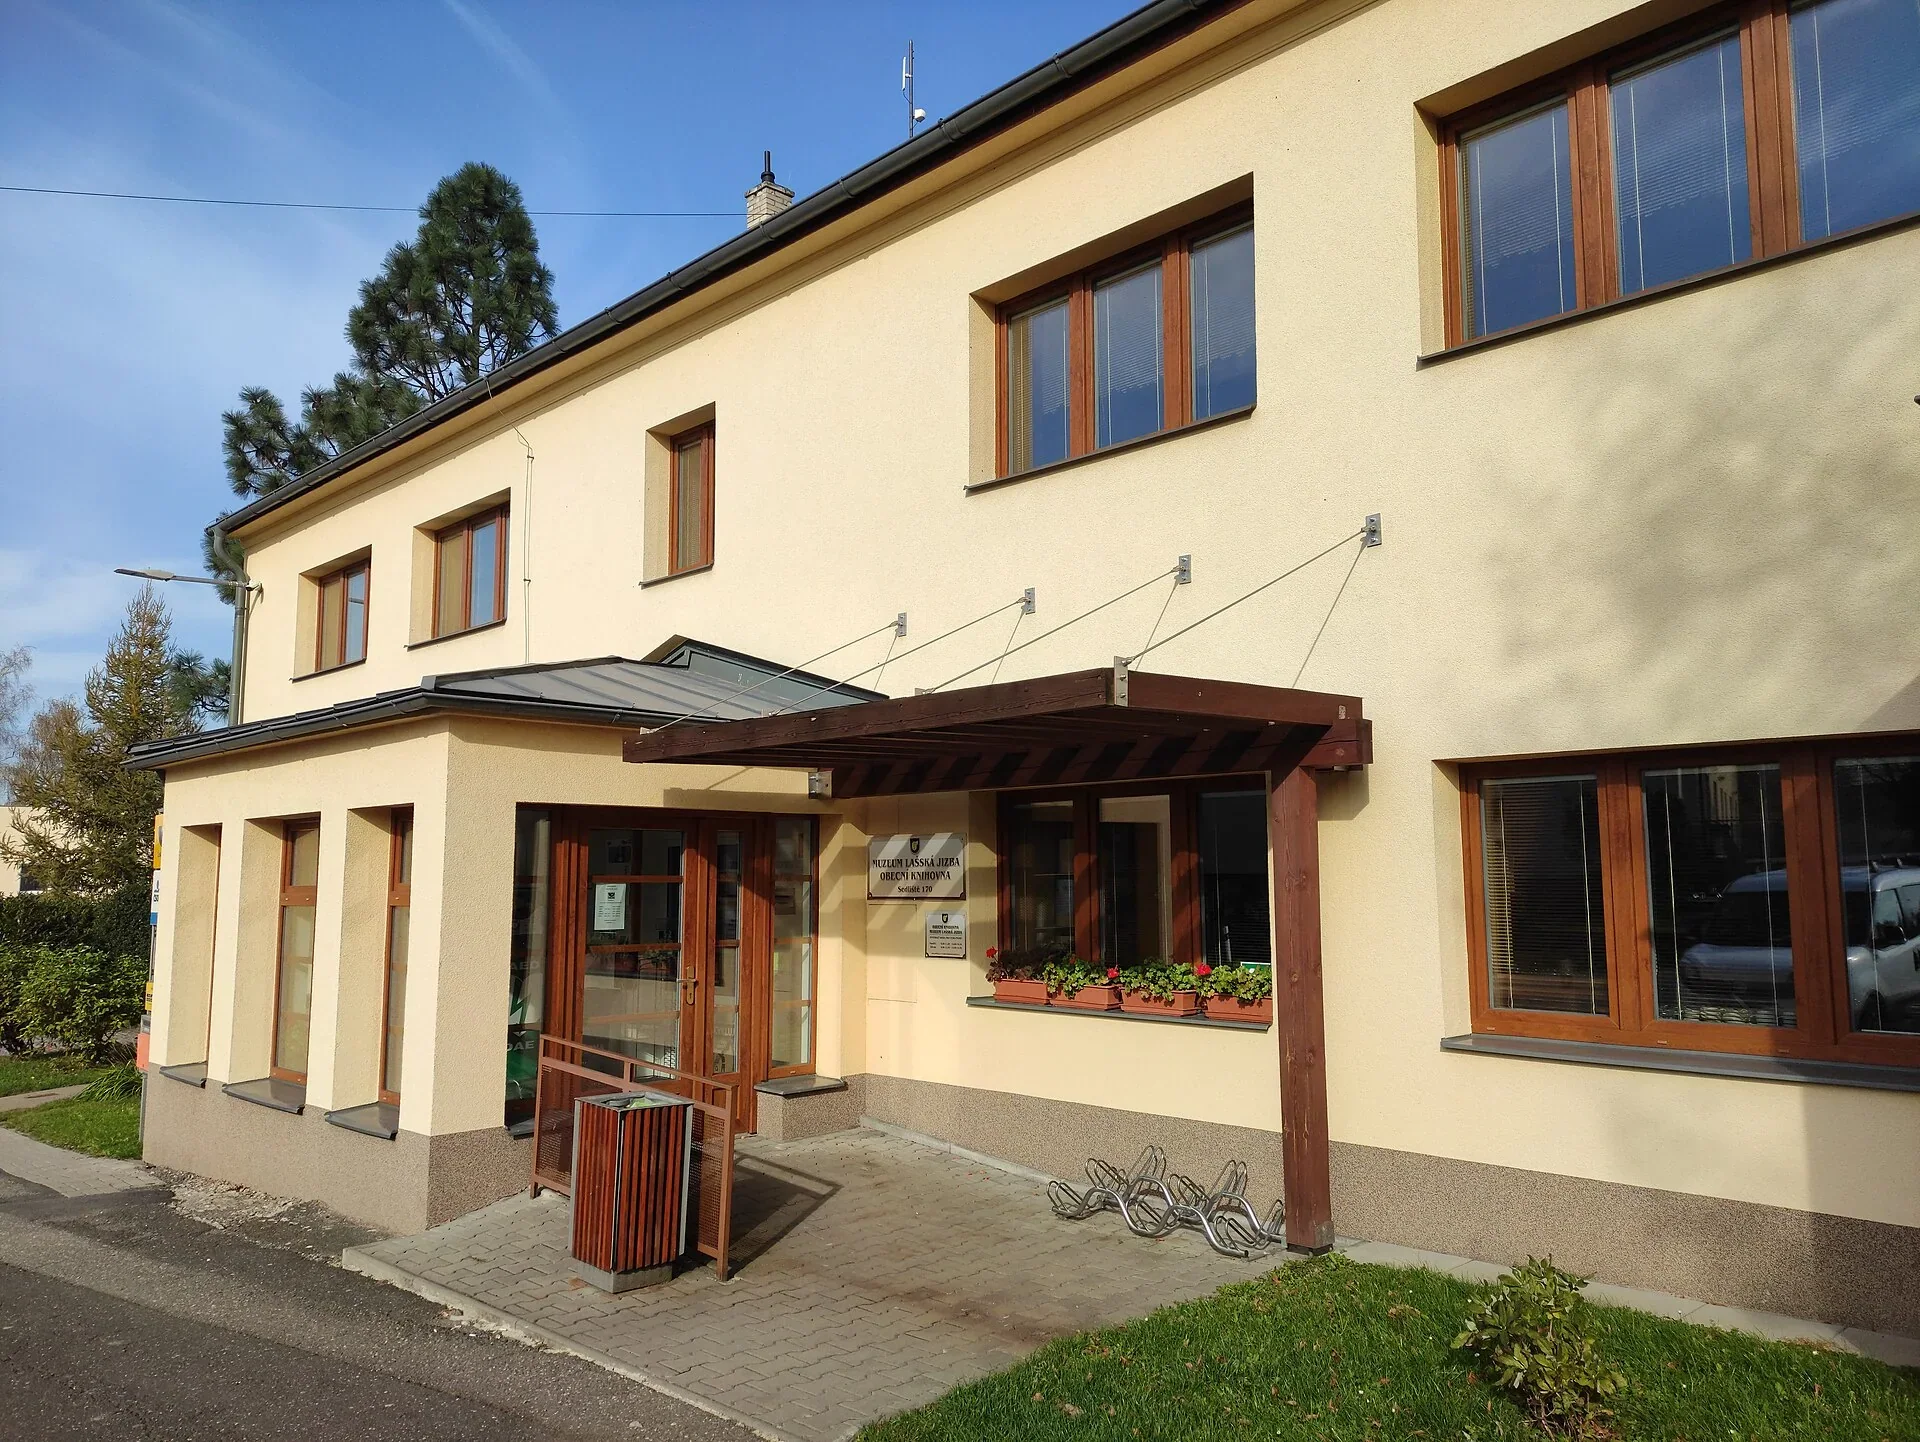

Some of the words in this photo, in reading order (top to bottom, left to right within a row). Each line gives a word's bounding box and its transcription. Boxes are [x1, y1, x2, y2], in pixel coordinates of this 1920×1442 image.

[872, 858, 902, 868] MUZEUM
[905, 855, 934, 868] LAŠSKÁ
[936, 857, 960, 867] JIZBA
[880, 868, 909, 881] OBECNÍ
[911, 871, 951, 881] KNIHOVNA
[922, 885, 933, 893] 170
